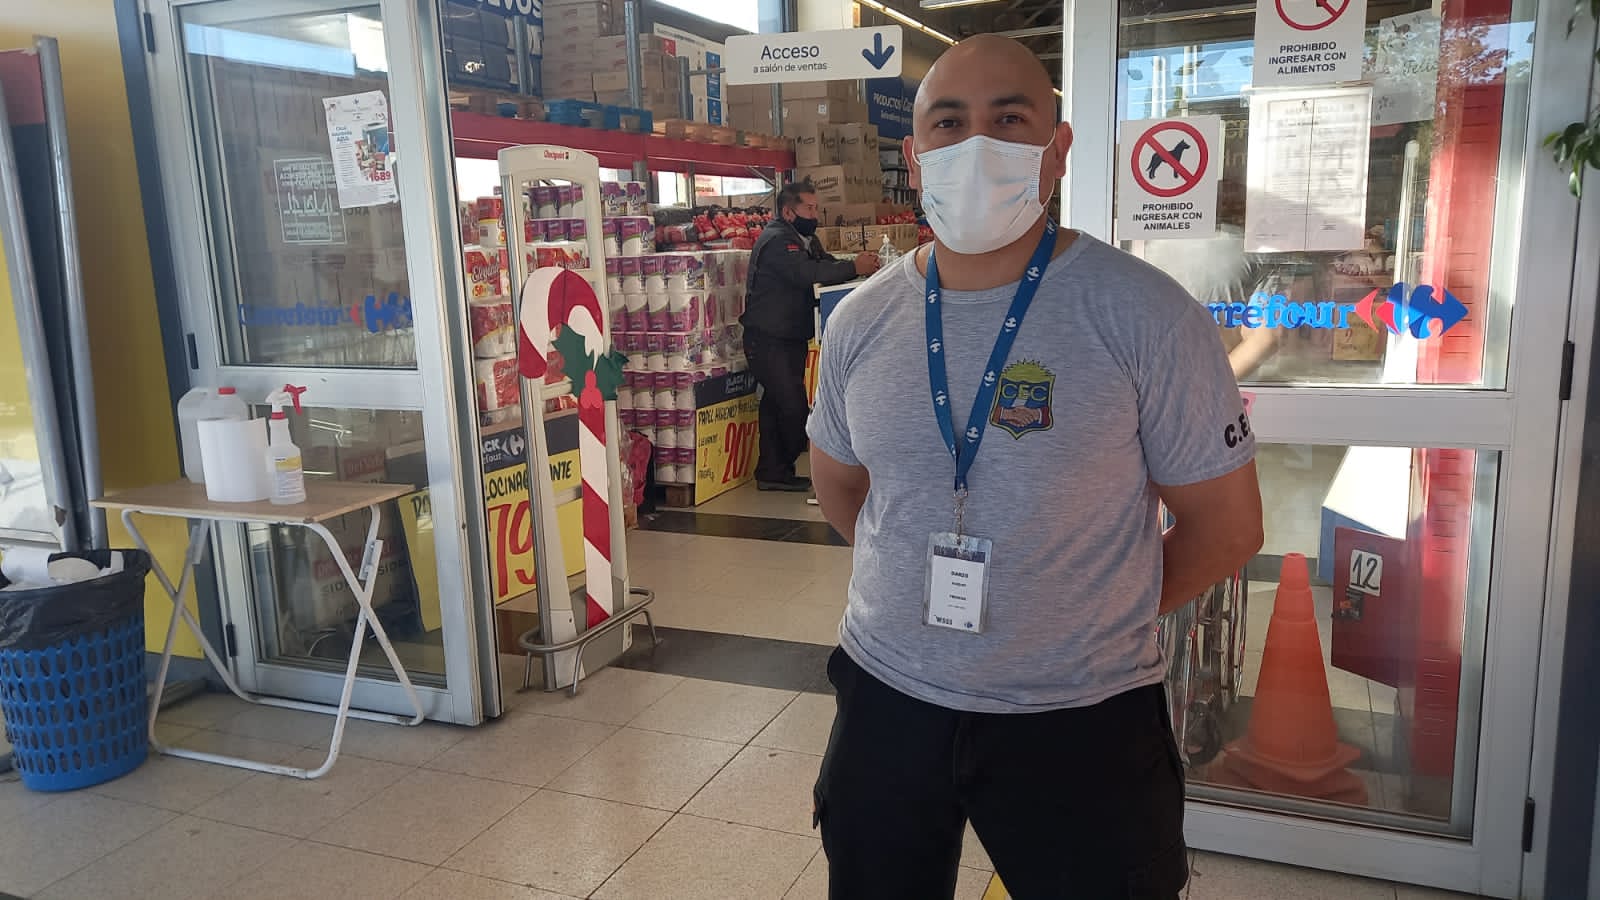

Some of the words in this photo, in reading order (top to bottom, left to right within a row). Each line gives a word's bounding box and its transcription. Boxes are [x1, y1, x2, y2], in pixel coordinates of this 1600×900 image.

[760, 44, 820, 61] Acceso
[1279, 41, 1337, 54] PROHIBIDO
[1268, 54, 1321, 66] INGRESAR
[1324, 52, 1347, 63] CON
[753, 66, 759, 74] a
[759, 62, 783, 74] salón
[784, 62, 796, 73] de
[798, 61, 828, 72] ventas
[1276, 63, 1336, 75] ALIMENTOS
[1142, 201, 1194, 212] PROHIBIDO
[1132, 212, 1181, 222] INGRESAR
[1182, 211, 1203, 221] CON
[1143, 221, 1191, 231] ANIMALES
[1207, 295, 1355, 329] rrefour
[1001, 384, 1048, 402] CEC
[1224, 412, 1250, 449] C.E
[1350, 553, 1379, 591] 12
